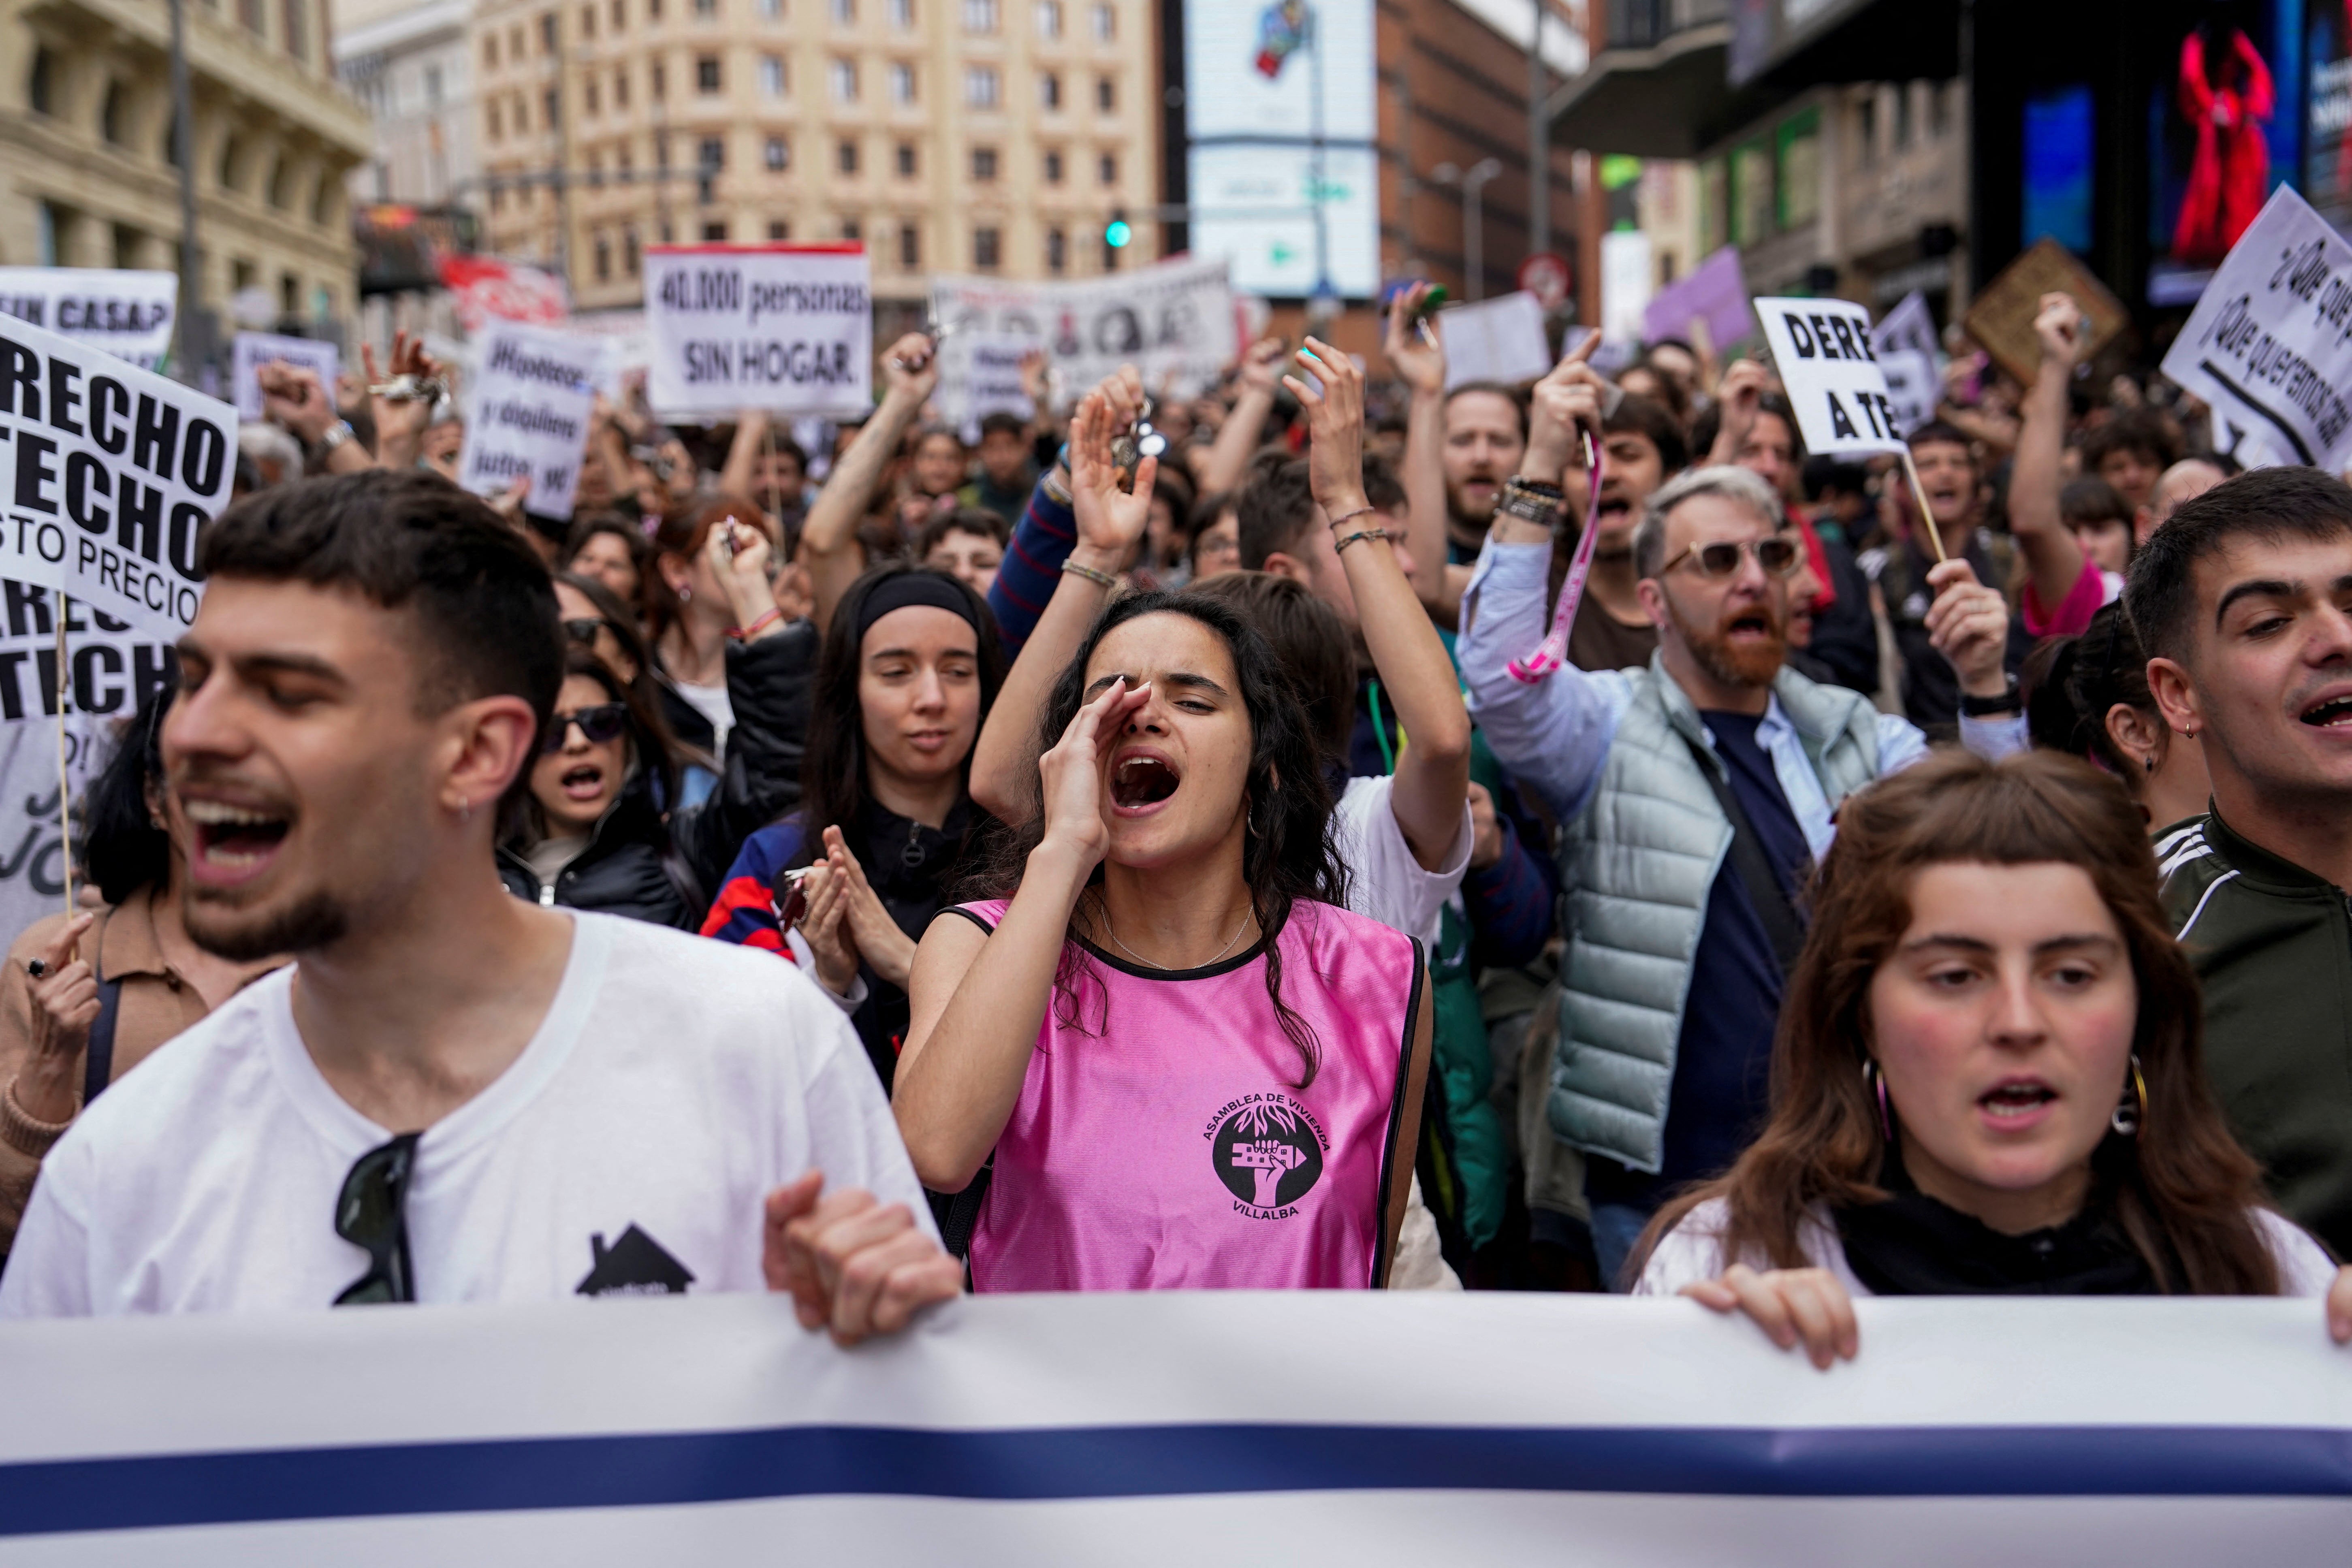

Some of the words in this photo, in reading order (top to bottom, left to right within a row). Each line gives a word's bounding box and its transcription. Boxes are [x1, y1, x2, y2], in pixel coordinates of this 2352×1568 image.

[685, 341, 732, 383] SIN
[1828, 391, 1860, 438] A
[79, 535, 198, 626] PRECIO
[1203, 1093, 1263, 1141] ASAMBLEA
[1266, 1093, 1285, 1103] DE
[1289, 1098, 1330, 1152] VIVIENDA
[1233, 1200, 1299, 1220] VILLALBA
